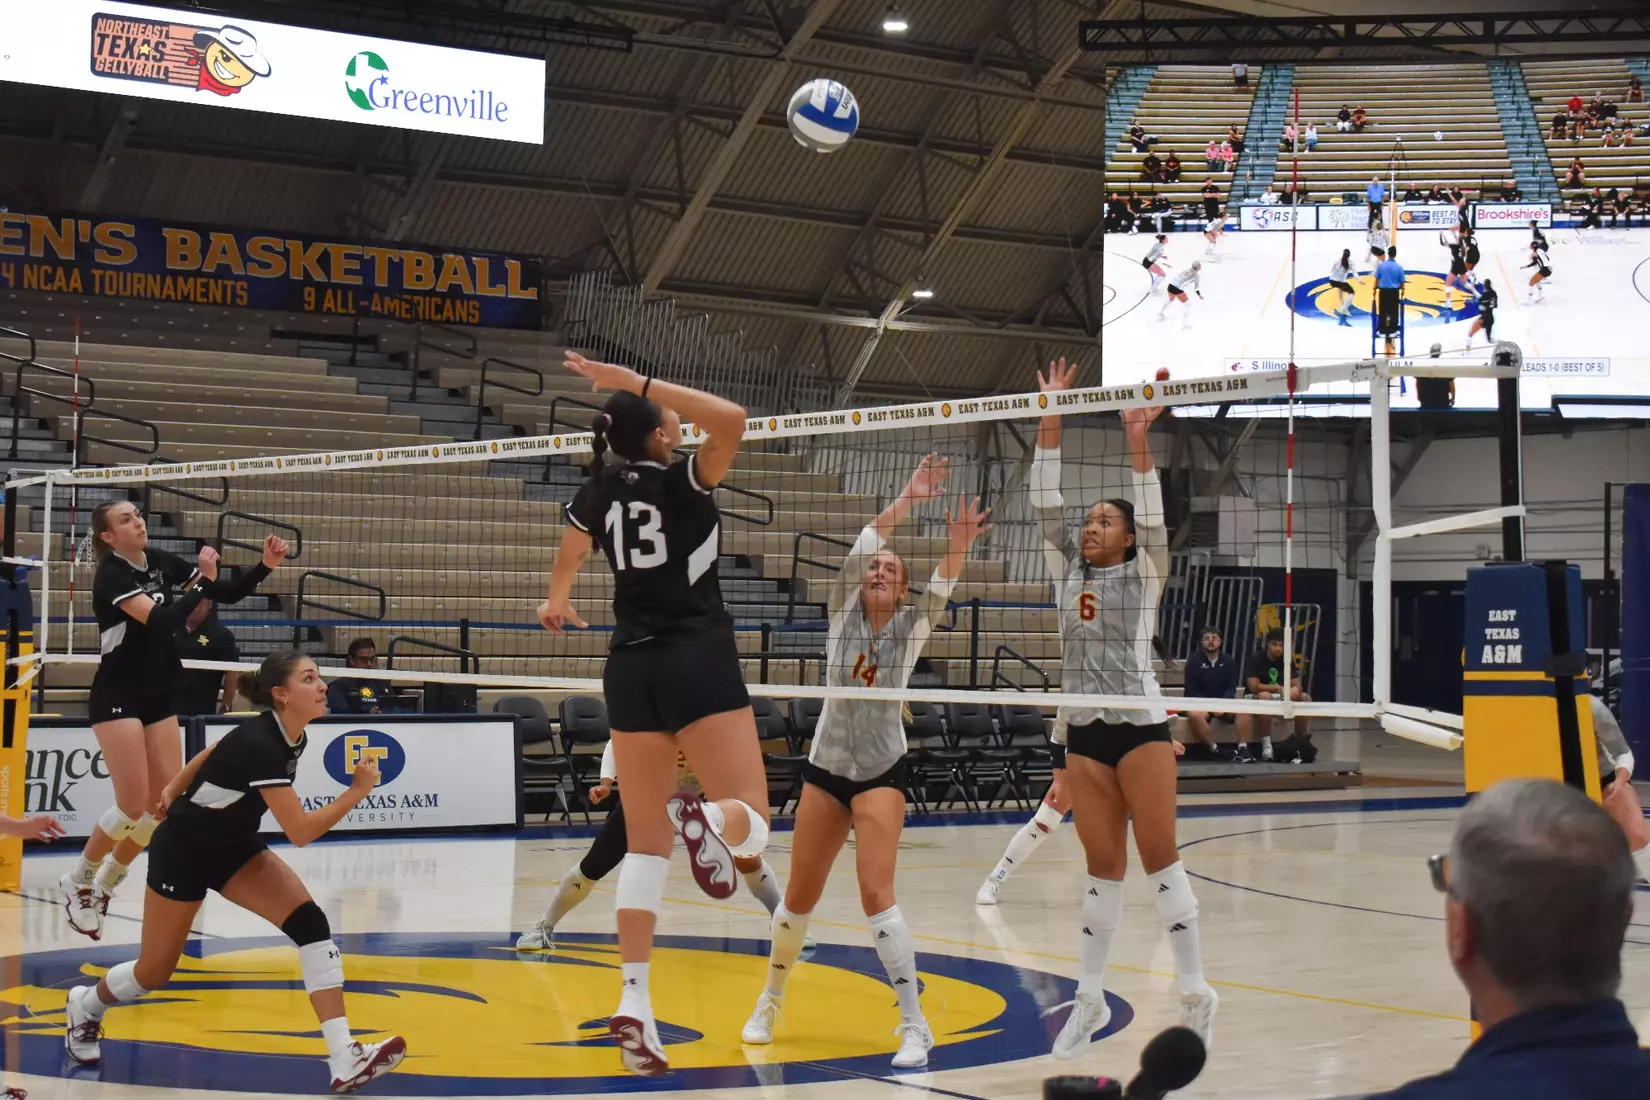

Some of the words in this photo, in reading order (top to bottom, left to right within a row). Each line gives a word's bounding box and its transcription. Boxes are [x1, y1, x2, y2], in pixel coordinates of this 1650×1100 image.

[96, 18, 169, 39] NORTHEAST
[96, 32, 168, 63] TEXAS
[95, 58, 167, 80] GELLYBALL
[368, 75, 508, 122] Greenville
[1478, 208, 1549, 220] Brookshire's
[162, 228, 538, 300] BASKETBALL
[23, 264, 84, 294] NCAA
[91, 269, 248, 306] TOURNAMENTS
[304, 286, 316, 312] 9
[322, 288, 480, 324] ALL-AMERICANS
[1252, 361, 1258, 370] S
[1262, 361, 1288, 370] Illino
[1522, 363, 1546, 372] LEADS
[1549, 363, 1559, 371] 1-0
[1561, 362, 1584, 372] (BEST
[1586, 363, 1595, 371] OF
[1596, 362, 1604, 372] 5)
[1163, 384, 1187, 396] EAST
[1190, 381, 1222, 394] TEXAS
[1226, 378, 1248, 391] A&M
[958, 402, 979, 414] EAST
[982, 400, 1009, 412] TEXAS
[1011, 398, 1029, 409] A&M
[1056, 393, 1079, 405] EAST
[1082, 391, 1112, 404] TEXAS
[1114, 389, 1135, 400] A&M
[784, 418, 801, 428] EAST
[804, 416, 828, 426] TEXAS
[830, 414, 845, 425] A&M
[867, 410, 887, 422] EAST
[890, 409, 915, 420] TEXAS
[917, 407, 934, 418] A&M
[605, 500, 668, 570] 13
[1079, 592, 1096, 622] 6
[1488, 610, 1516, 622] EAST
[1484, 628, 1520, 640] TEXAS
[1481, 644, 1522, 664] A&M
[850, 652, 878, 688] 14
[344, 736, 388, 786] ET
[299, 796, 336, 811] AST
[353, 794, 396, 809] EXAS
[400, 793, 439, 808] A&M
[345, 812, 415, 822] VERSITY
